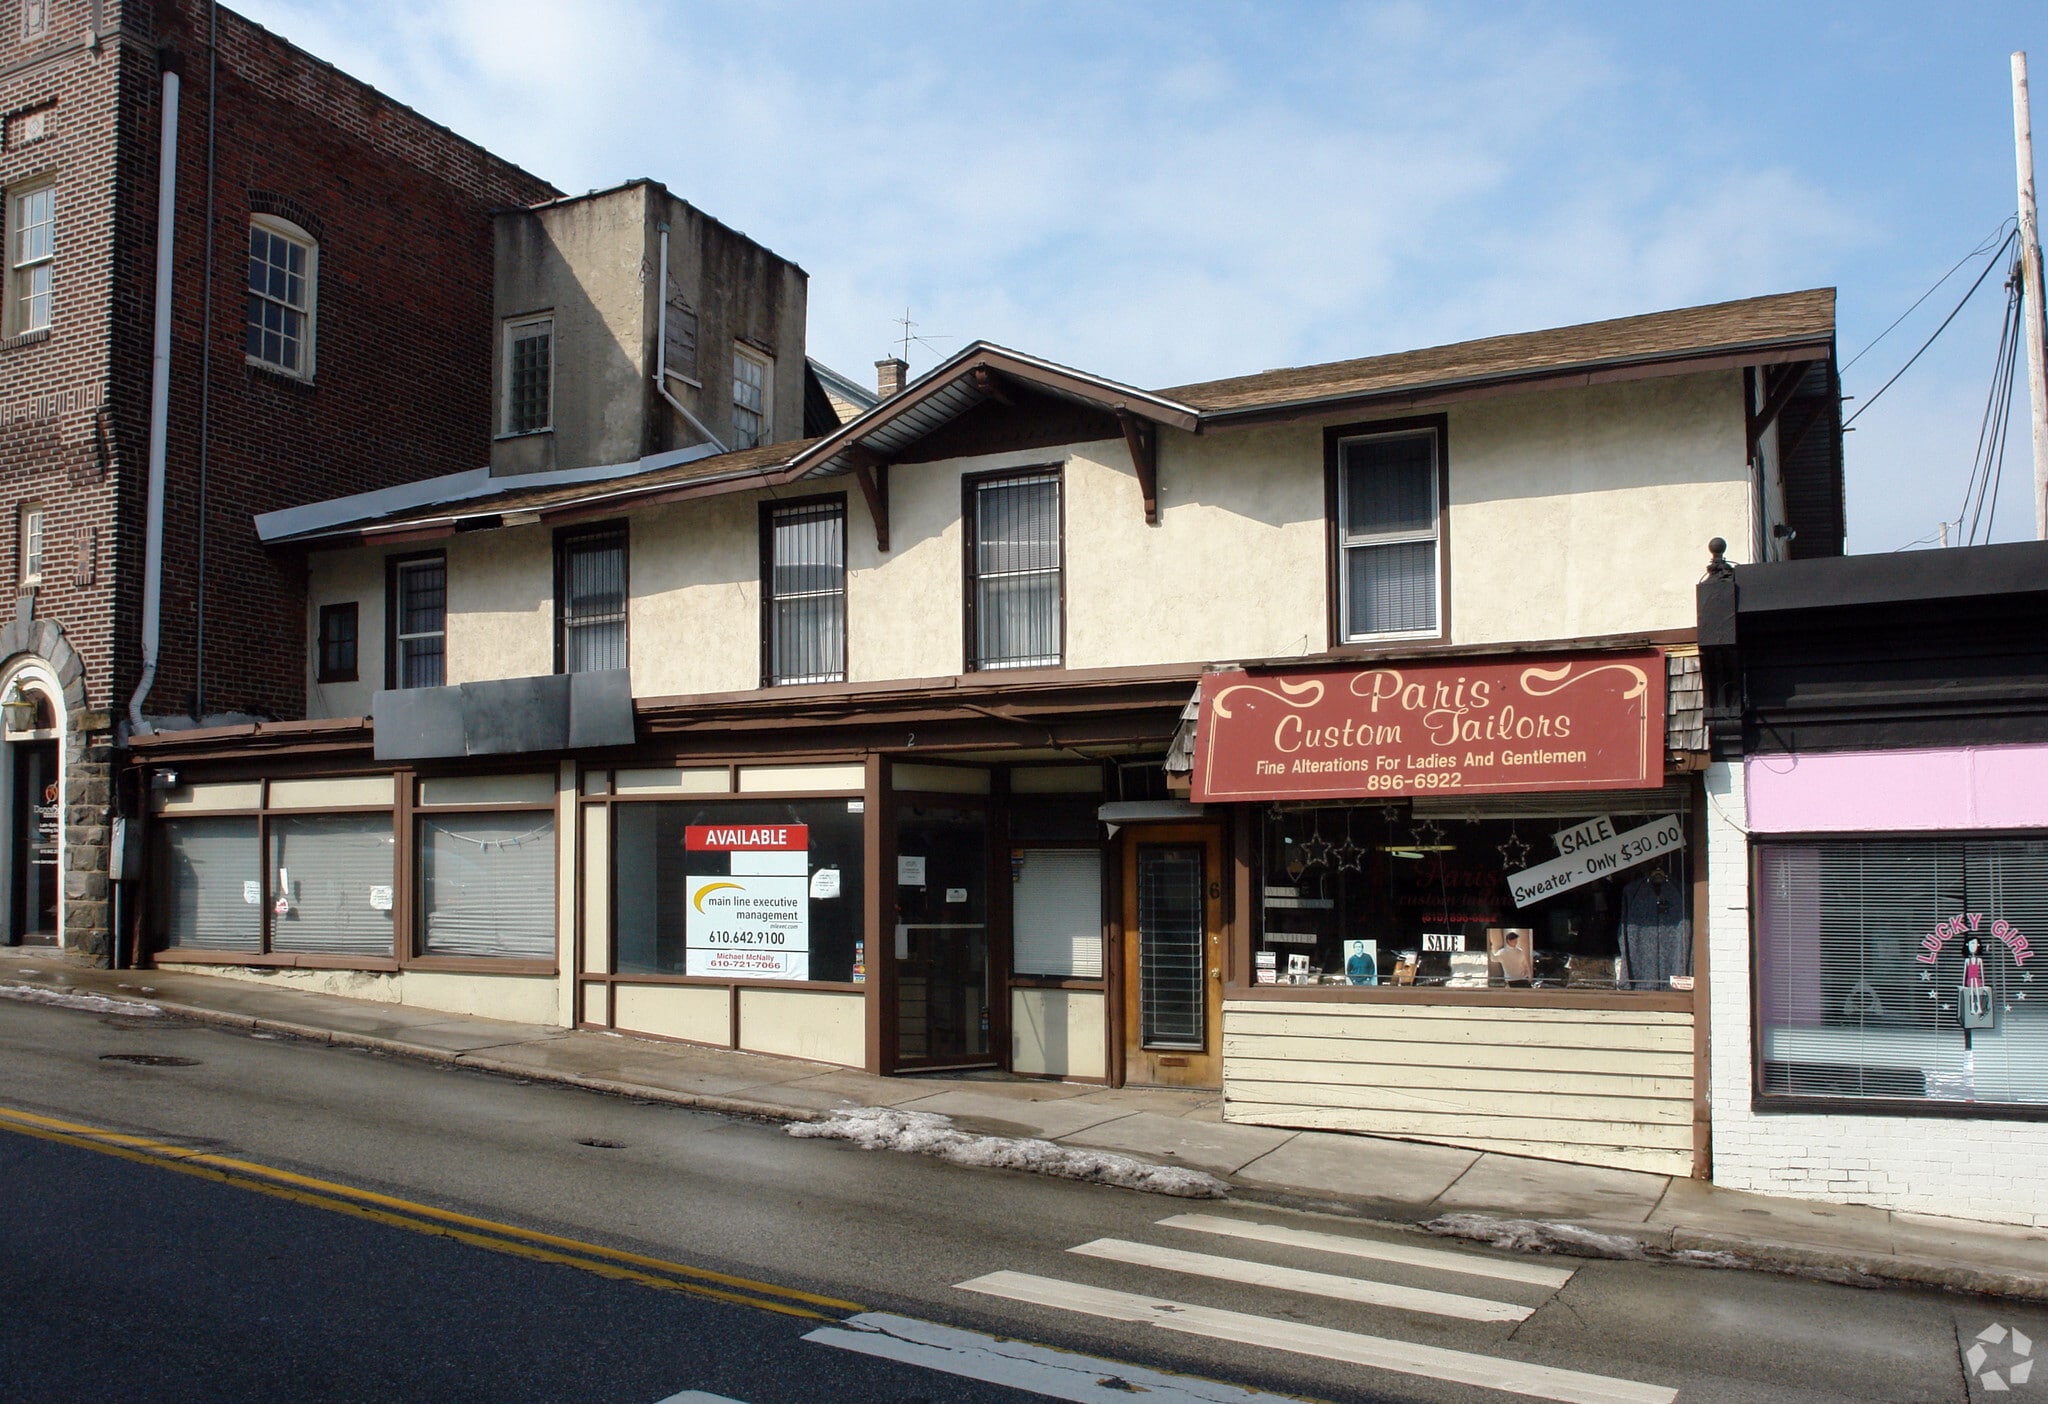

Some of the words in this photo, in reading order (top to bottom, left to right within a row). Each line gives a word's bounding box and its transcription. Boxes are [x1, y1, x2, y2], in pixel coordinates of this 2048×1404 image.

[1350, 668, 1490, 712] Paris
[1274, 715, 1402, 752] Custom
[1423, 705, 1571, 746] Tailors
[907, 732, 915, 747] 2
[1256, 760, 1285, 775] Fine
[1291, 756, 1369, 774] Alterations
[1376, 755, 1400, 771] For
[1407, 752, 1457, 769] Ladies
[1464, 751, 1494, 767] And
[1501, 749, 1586, 766] Gentlemen
[1367, 772, 1462, 790] 896-6922
[705, 829, 787, 845] AVAILABLE
[1561, 820, 1612, 855] SALE
[1514, 870, 1572, 902] Sweater
[1586, 852, 1617, 874] Only
[1620, 827, 1679, 862] $30.00
[1209, 881, 1220, 899] 6
[708, 896, 731, 907] main
[734, 895, 750, 906] line
[753, 896, 798, 907] executive
[736, 911, 798, 922] management
[709, 930, 785, 945] 610.642.9100
[1427, 935, 1458, 951] SALE
[1916, 912, 1983, 964] LUCKY
[1991, 919, 2034, 967] GIRL
[710, 960, 781, 969] 610-721-7066
[716, 952, 744, 961] Michael
[746, 953, 774, 962] McNally
